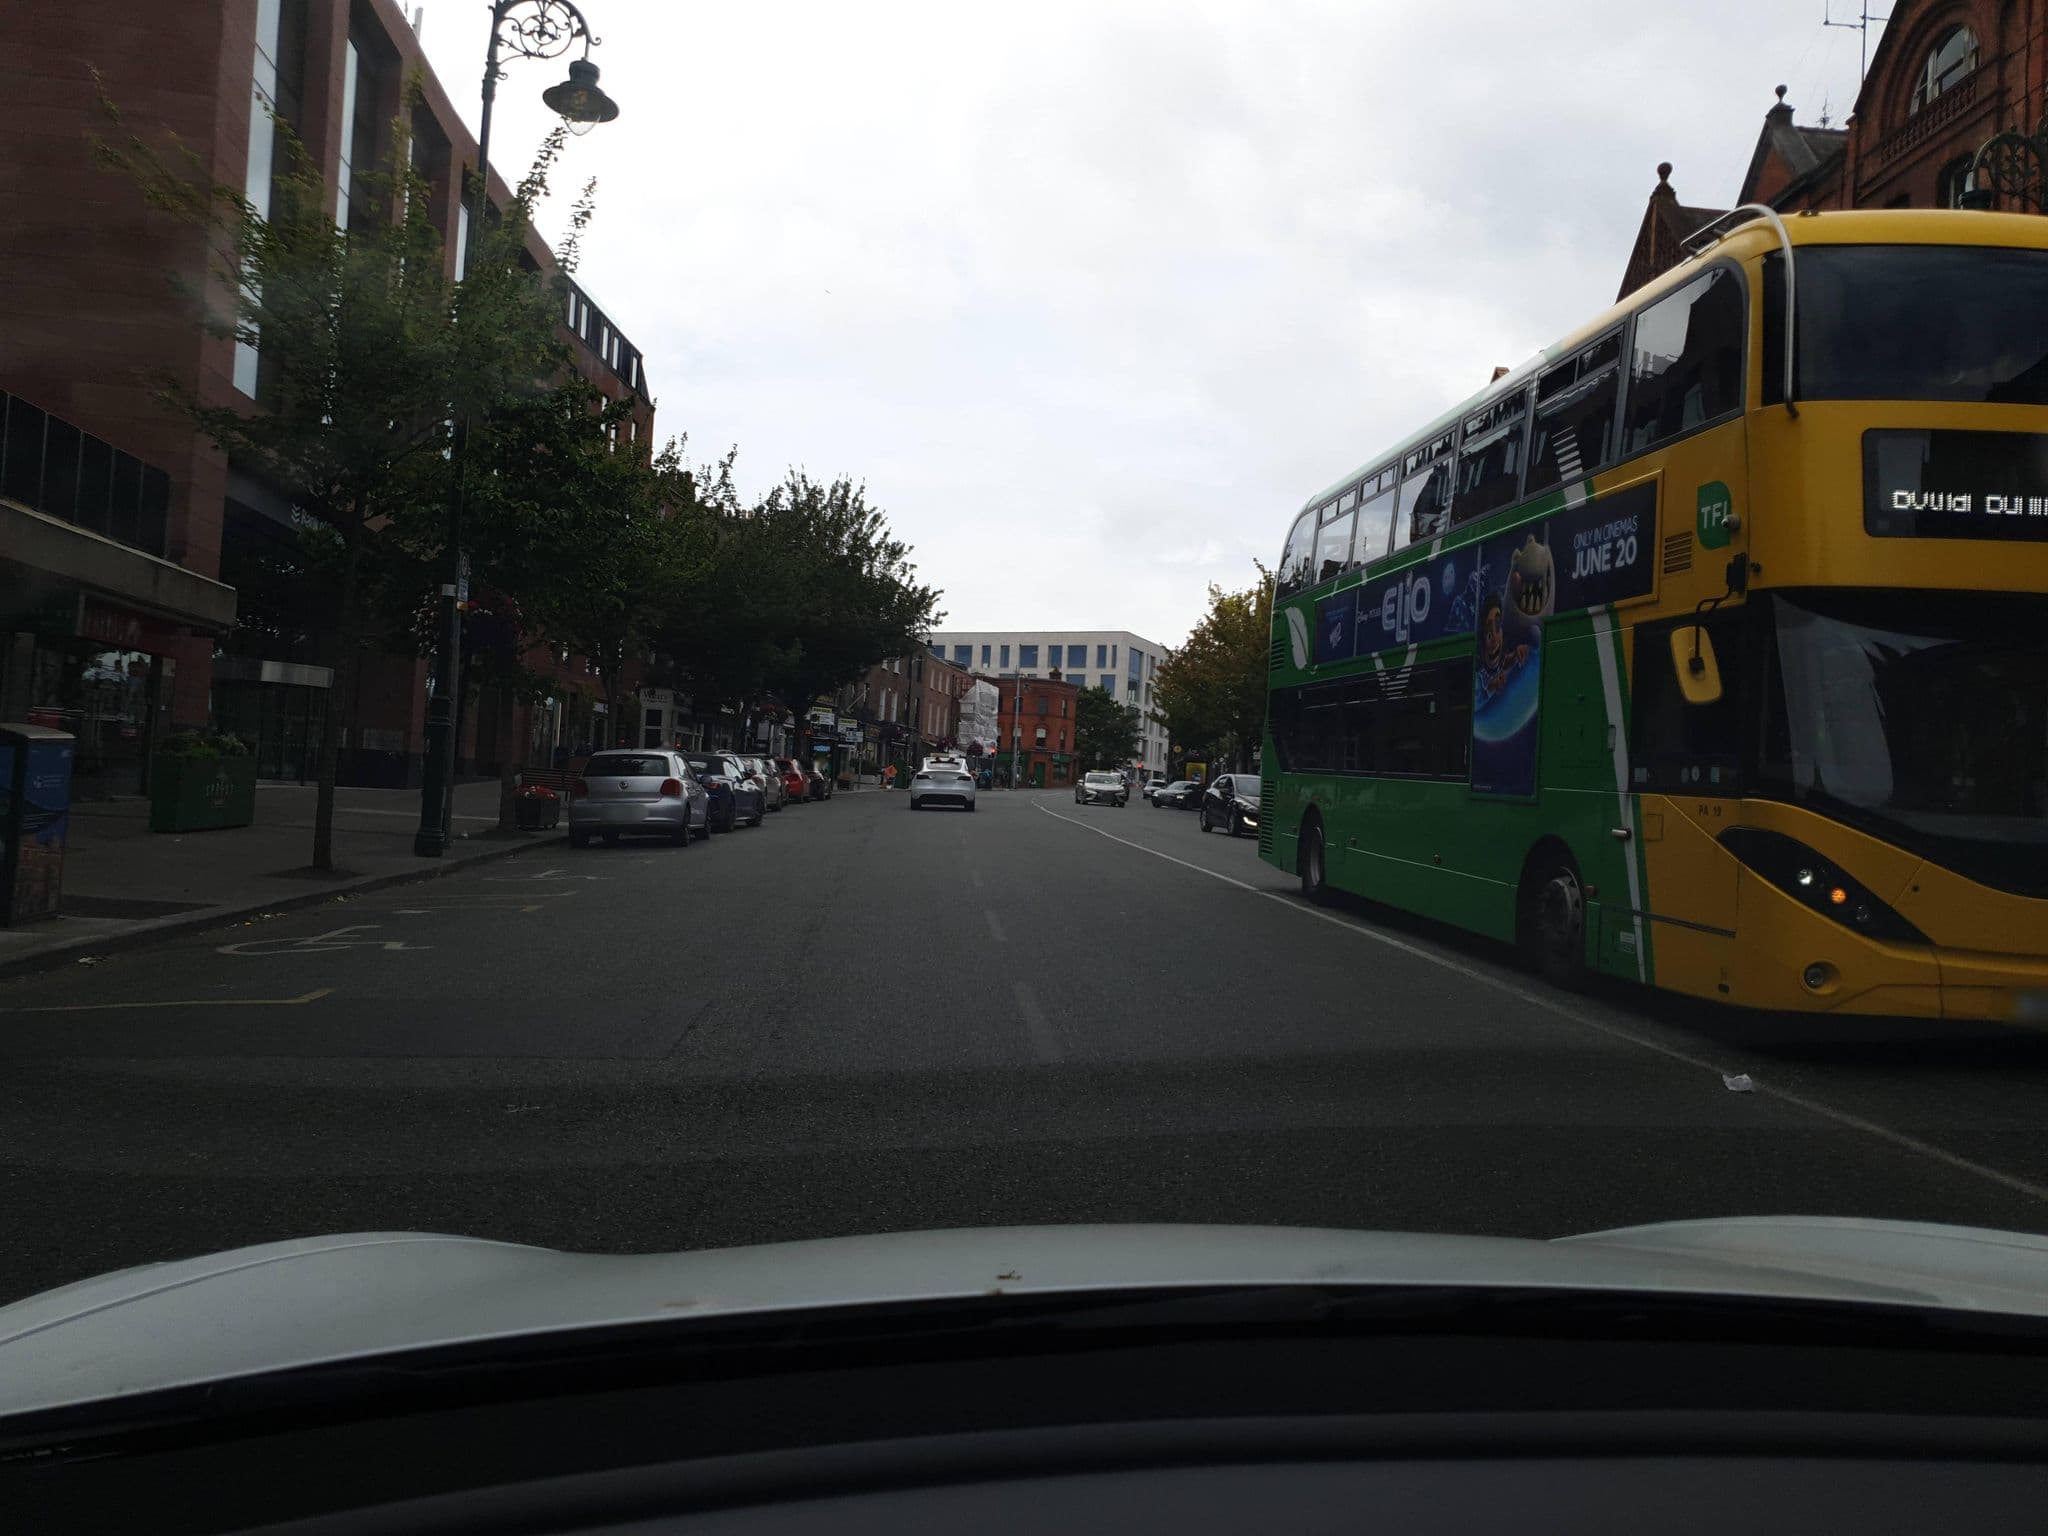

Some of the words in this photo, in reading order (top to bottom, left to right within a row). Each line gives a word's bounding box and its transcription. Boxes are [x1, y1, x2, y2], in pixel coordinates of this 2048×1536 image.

[1573, 529, 1594, 549] ONLY
[1594, 527, 1603, 544] IN
[1602, 515, 1638, 541] CINEMAS
[1571, 543, 1612, 579] JUNE
[1615, 535, 1638, 568] 20
